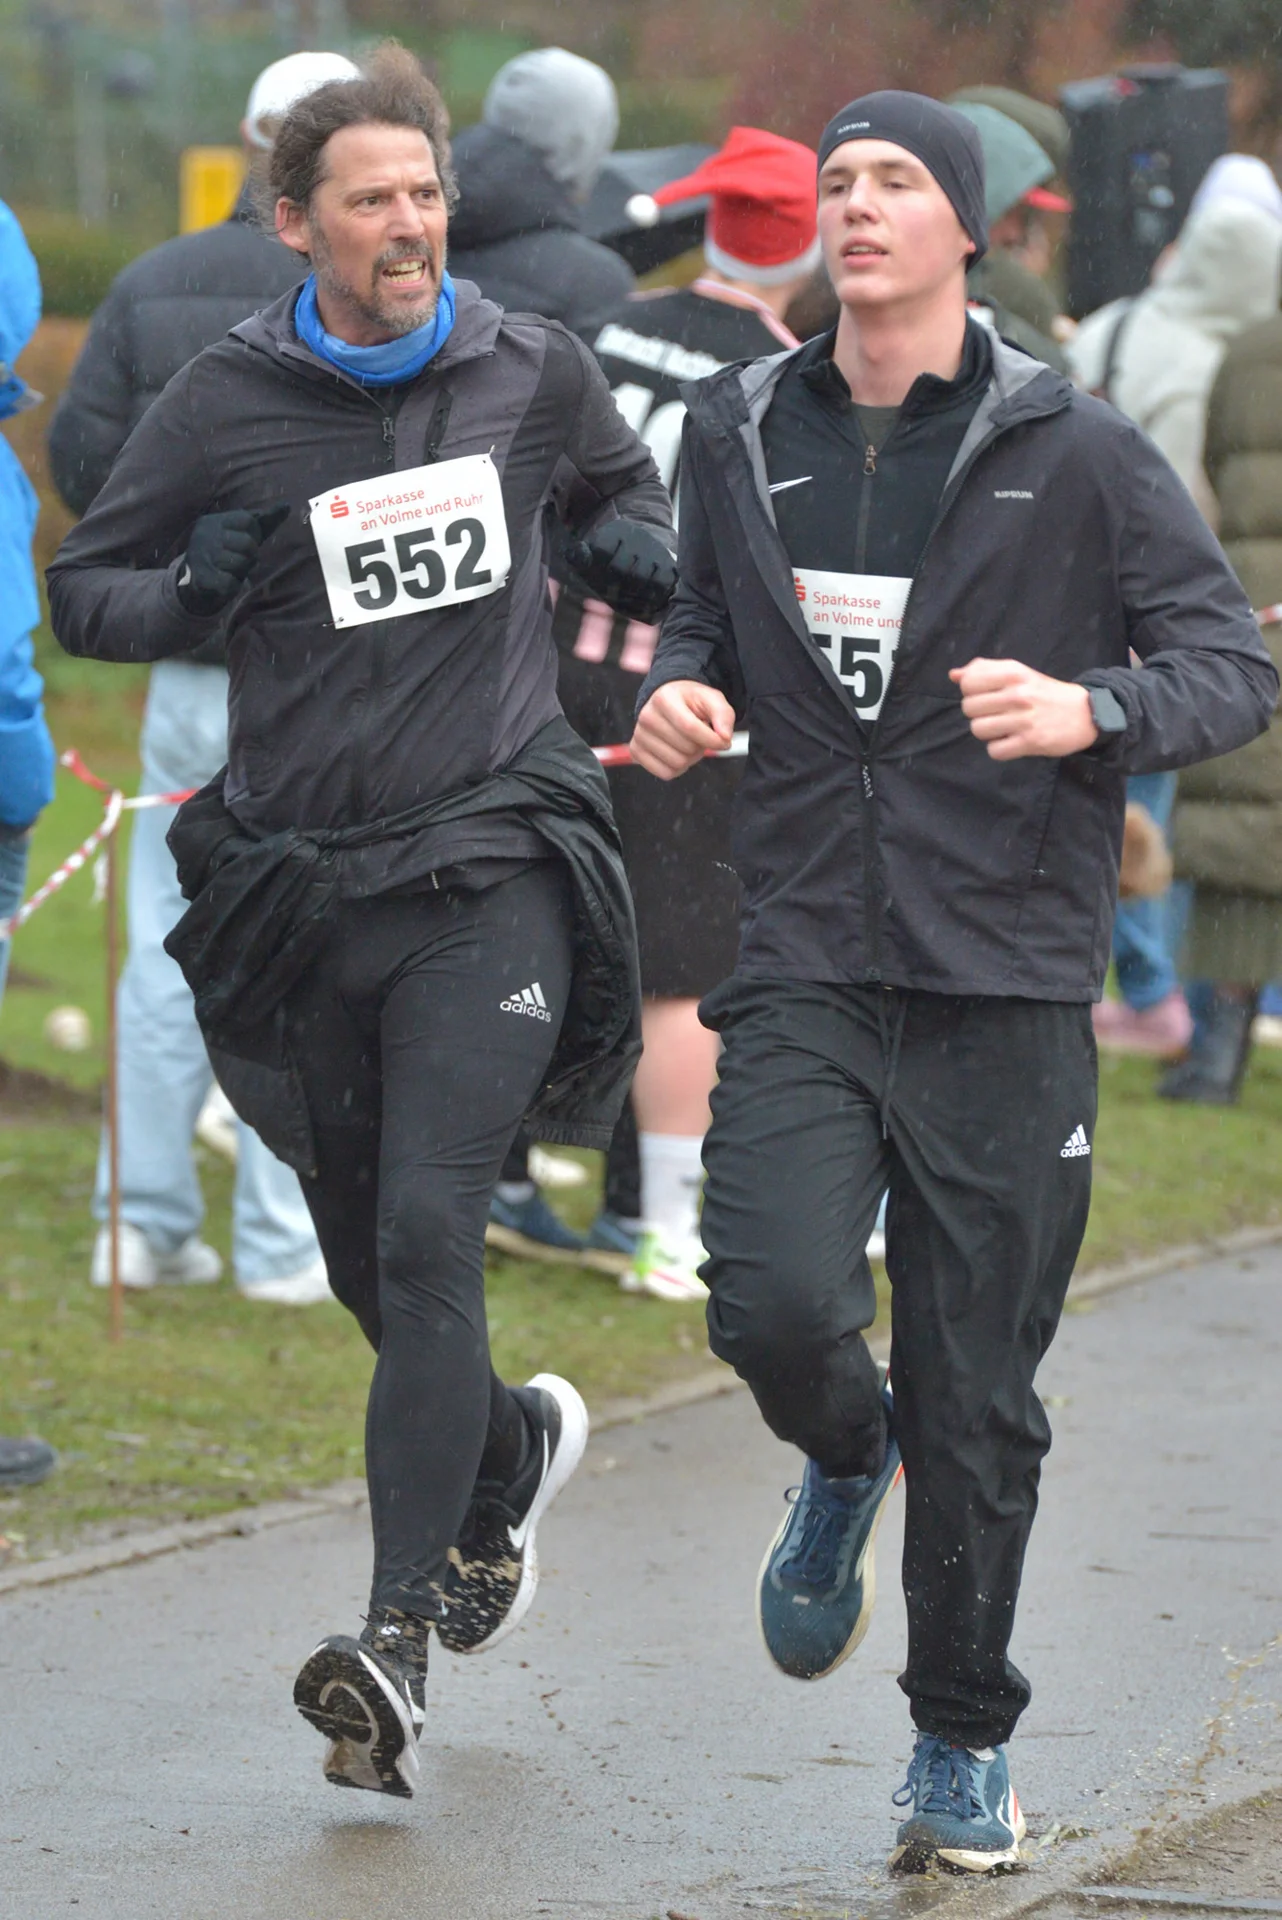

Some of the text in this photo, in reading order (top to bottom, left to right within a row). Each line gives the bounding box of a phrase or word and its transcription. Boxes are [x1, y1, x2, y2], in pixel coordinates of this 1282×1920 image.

[356, 489, 425, 514] Sparkasse
[361, 493, 484, 531] an Volme und Ruhr
[344, 517, 492, 611] 552
[813, 591, 881, 609] Sparkasse
[813, 612, 829, 623] an
[832, 611, 874, 627] Volme
[500, 1000, 552, 1023] adidas
[1060, 1144, 1091, 1158] adidas
